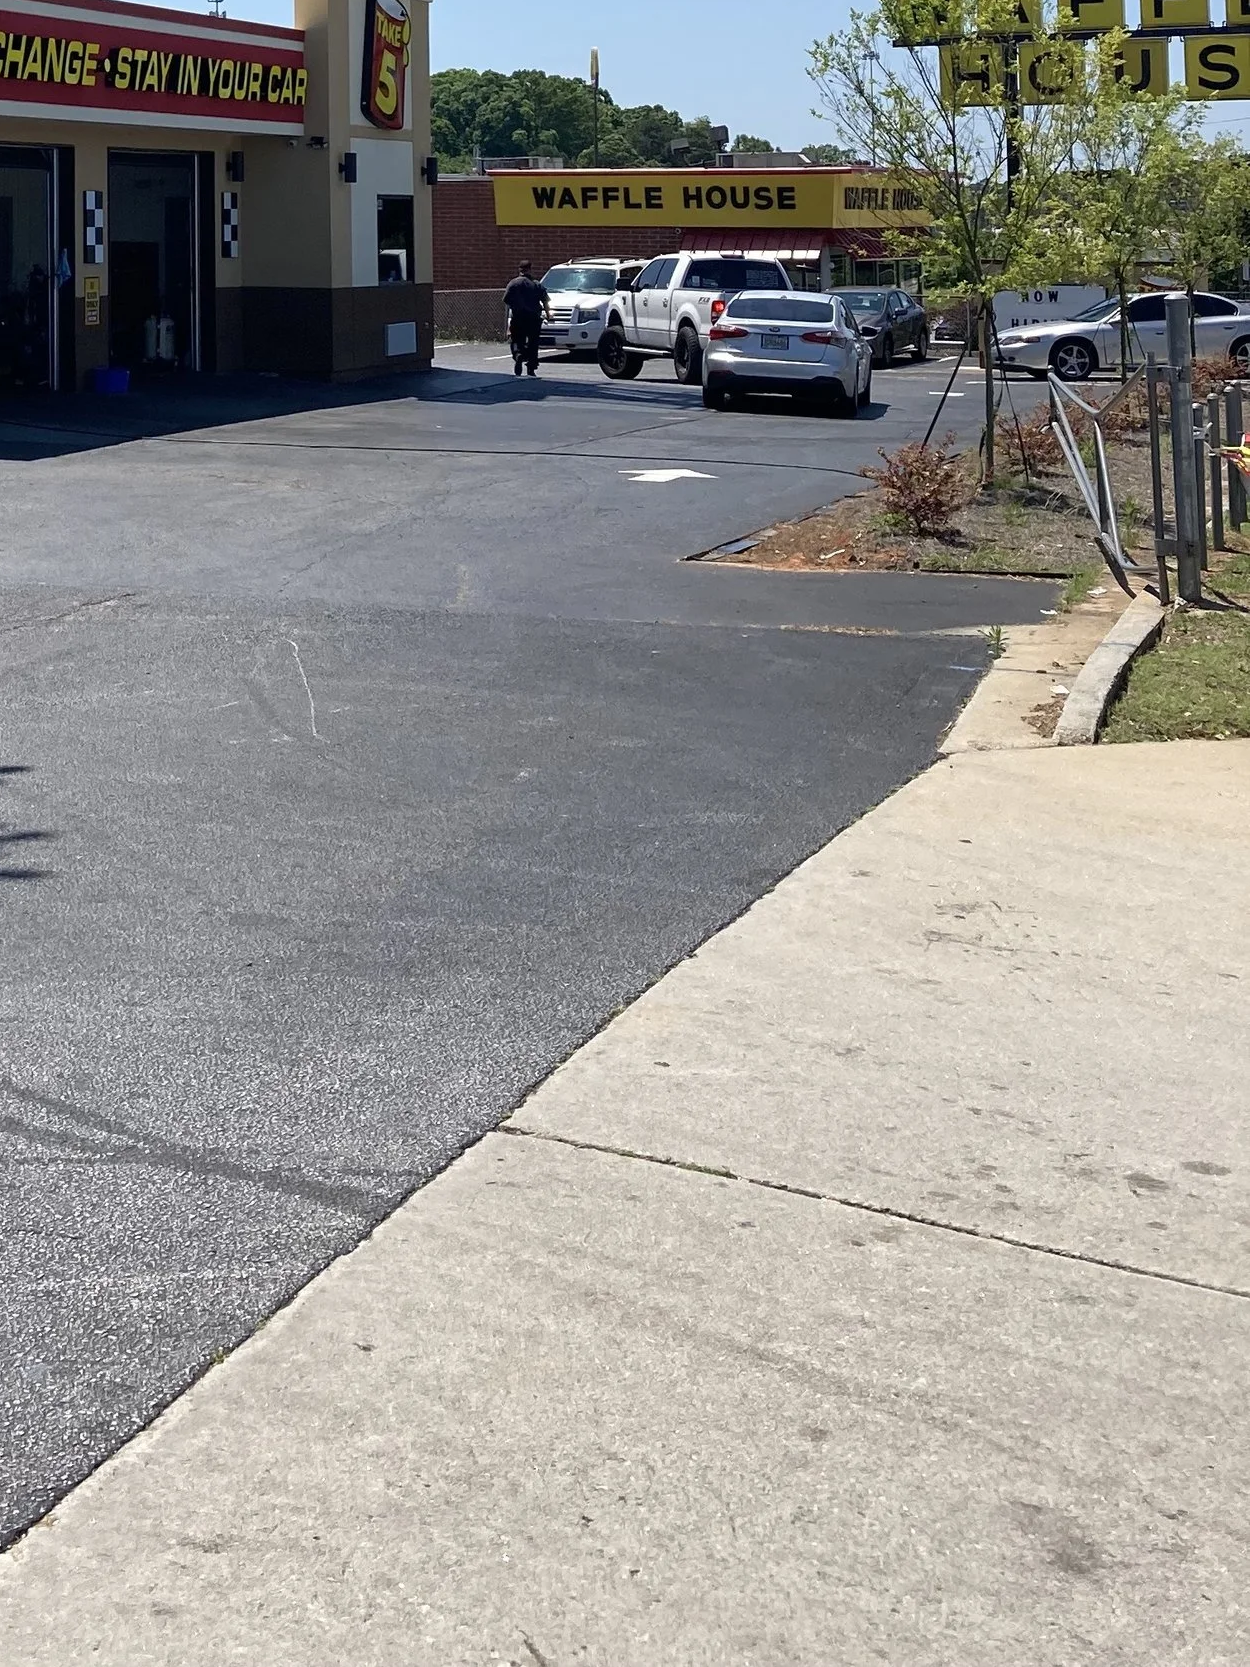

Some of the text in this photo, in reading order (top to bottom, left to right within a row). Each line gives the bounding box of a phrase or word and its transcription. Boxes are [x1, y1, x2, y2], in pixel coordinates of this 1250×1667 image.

[375, 10, 402, 48] TAKE
[114, 47, 173, 93] STAY
[177, 54, 202, 96] IN
[208, 57, 263, 102] YOUR
[267, 65, 308, 106] CAR
[374, 48, 398, 115] 5
[532, 185, 796, 210] WAFFLE HOUSE
[844, 187, 889, 210] WAFFLE
